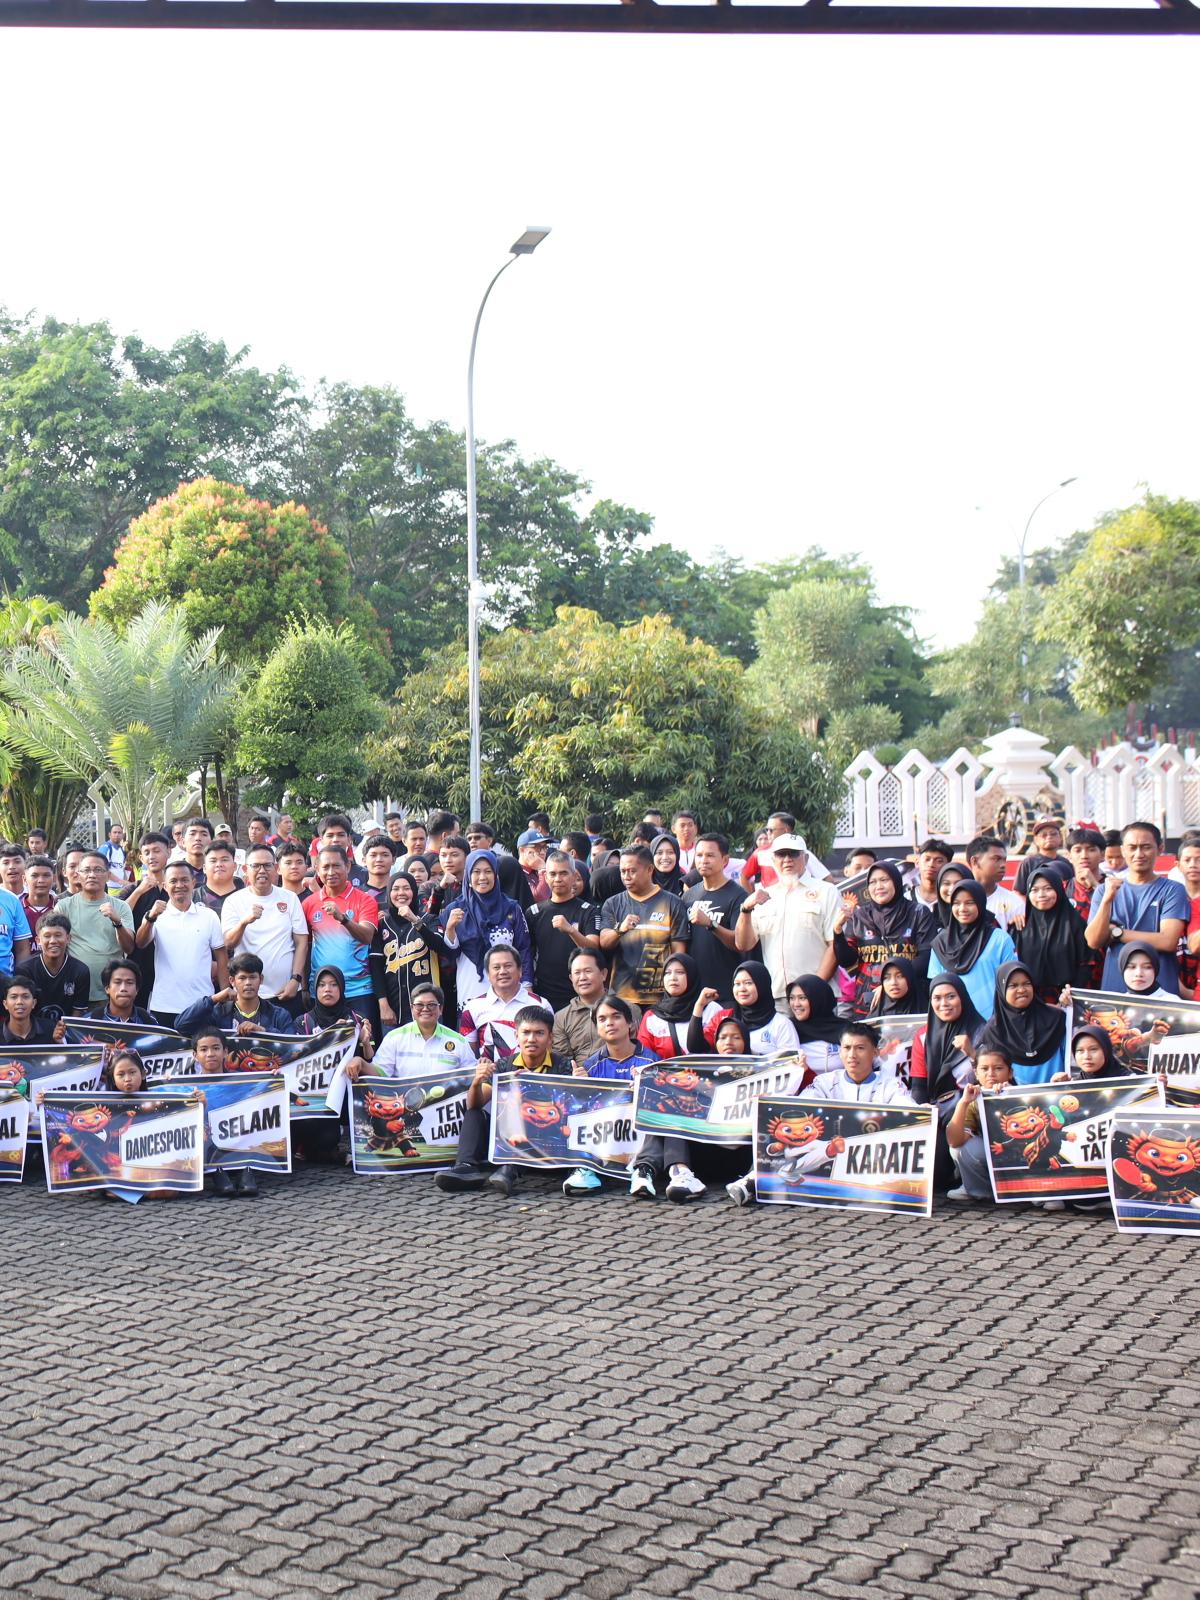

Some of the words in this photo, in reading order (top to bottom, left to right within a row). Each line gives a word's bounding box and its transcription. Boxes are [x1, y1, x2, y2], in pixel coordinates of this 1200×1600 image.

[412, 959, 430, 976] 43
[145, 1057, 196, 1076] SEPAK
[218, 1104, 282, 1141] SELAM
[125, 1123, 197, 1160] DANCESPORT
[845, 1139, 927, 1175] KARATE
